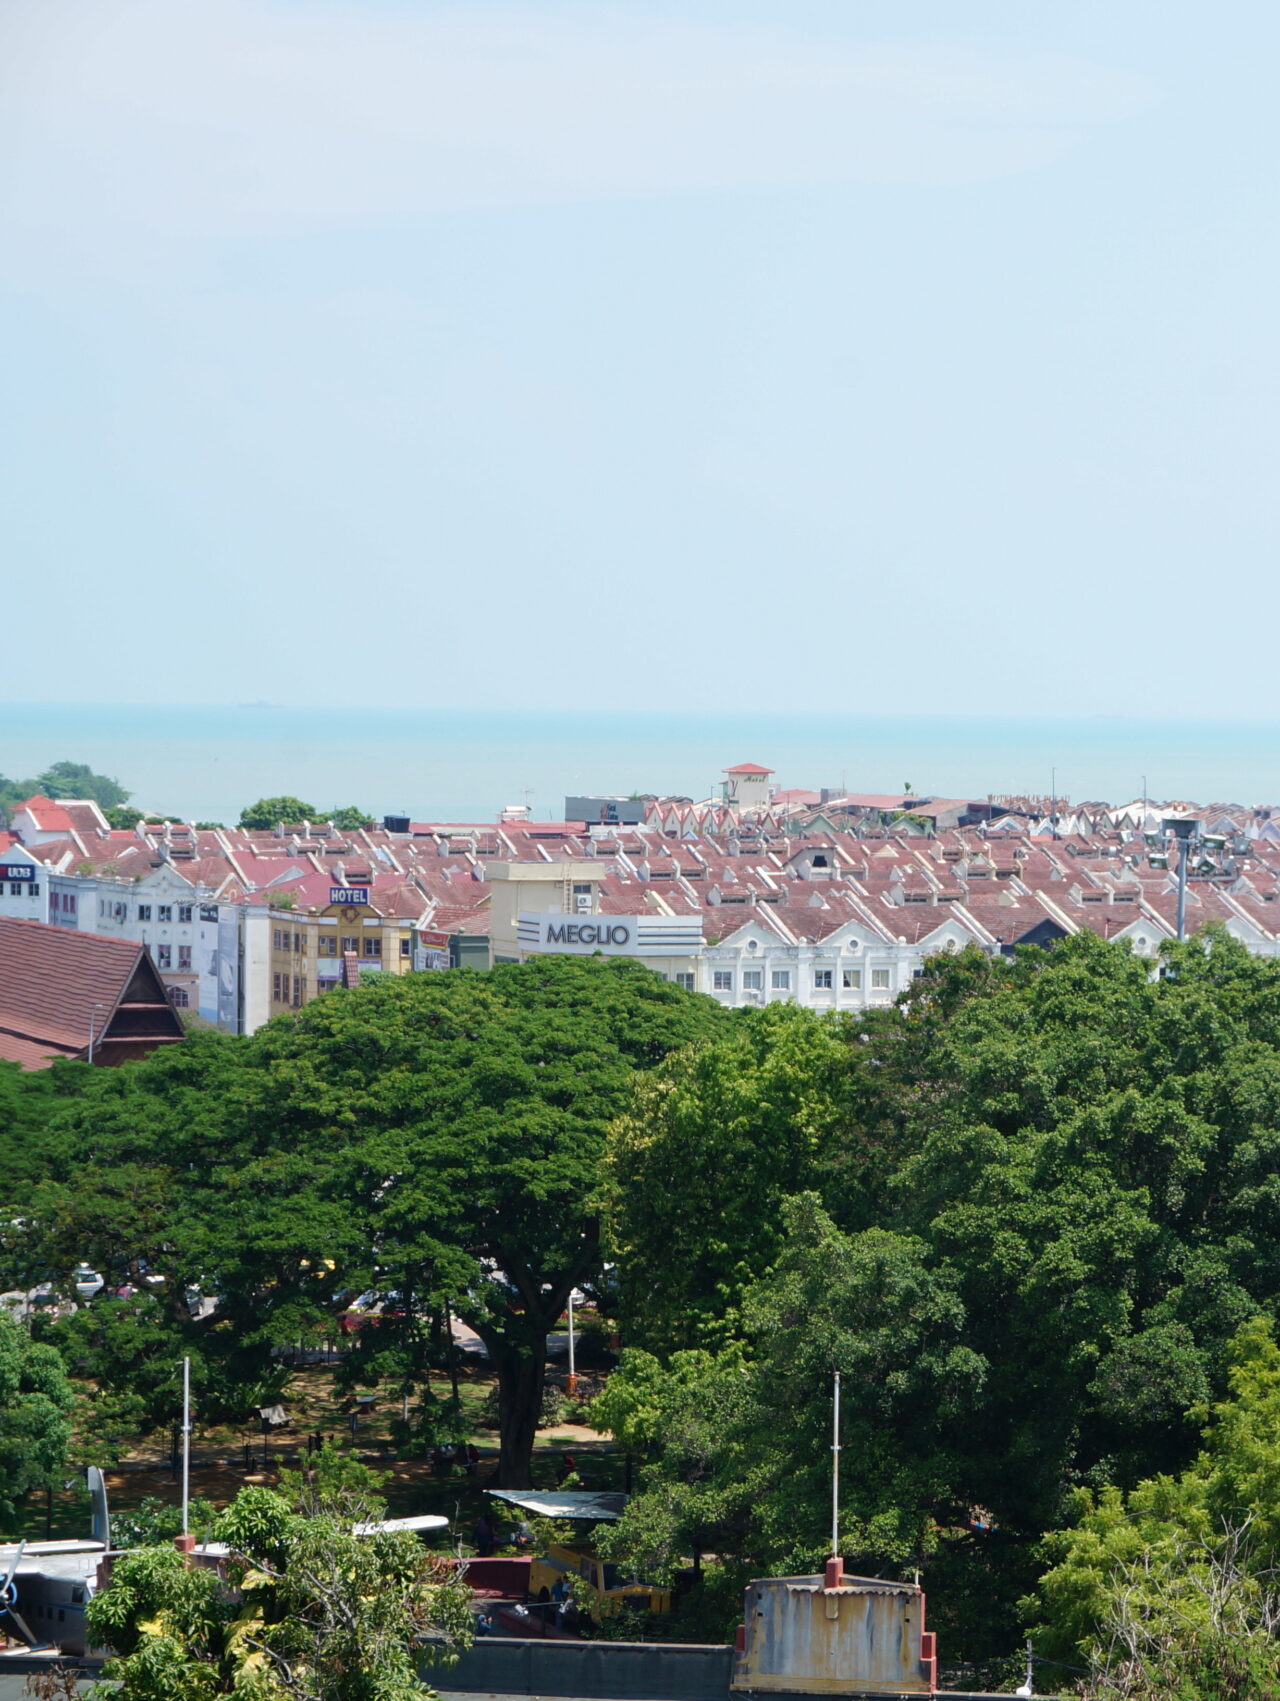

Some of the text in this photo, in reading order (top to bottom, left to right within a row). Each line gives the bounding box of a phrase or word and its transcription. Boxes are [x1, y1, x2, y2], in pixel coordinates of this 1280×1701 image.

[8, 867, 31, 878] UOB
[331, 888, 366, 902] HOTEL
[547, 923, 630, 945] MEGLIO
